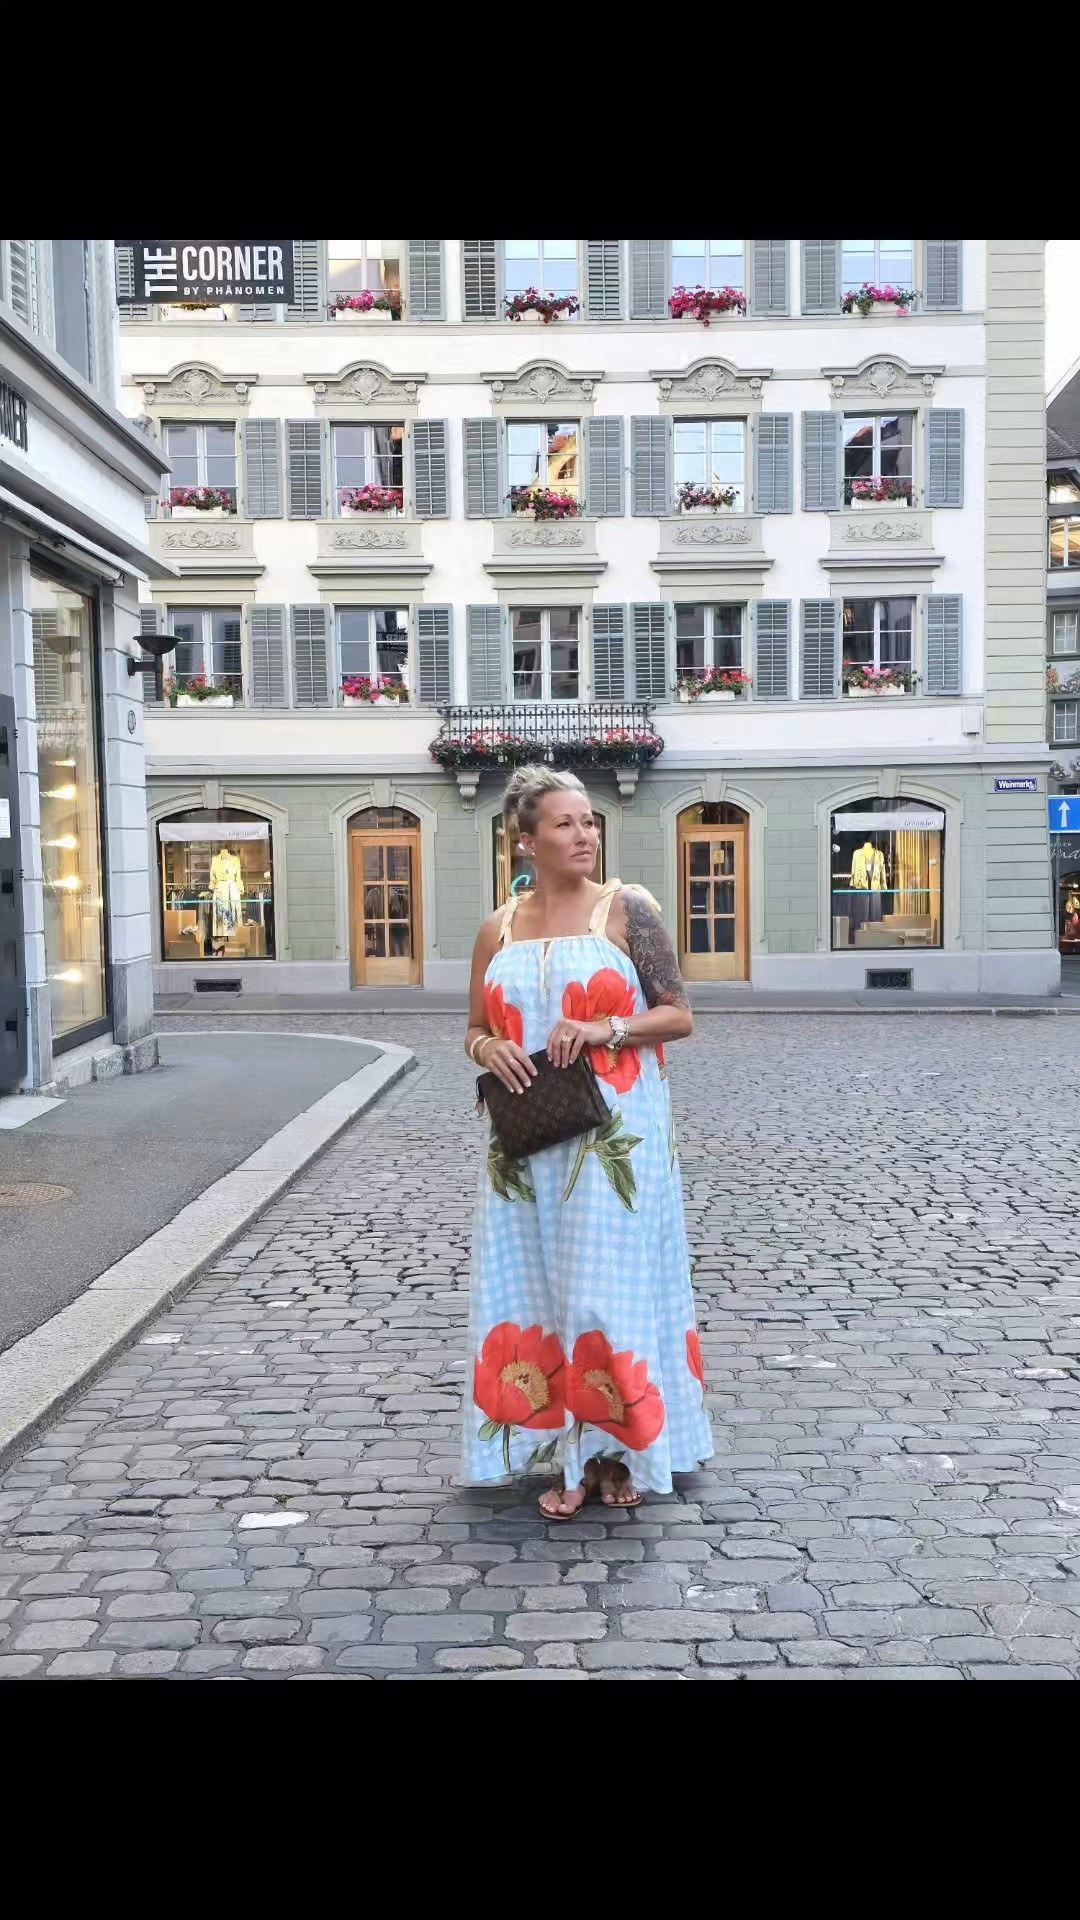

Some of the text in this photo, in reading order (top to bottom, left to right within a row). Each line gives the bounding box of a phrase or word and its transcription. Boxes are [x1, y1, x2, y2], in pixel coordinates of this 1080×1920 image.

[143, 245, 284, 298] THE CORNER
[183, 284, 285, 296] BY PHÄNOMEN
